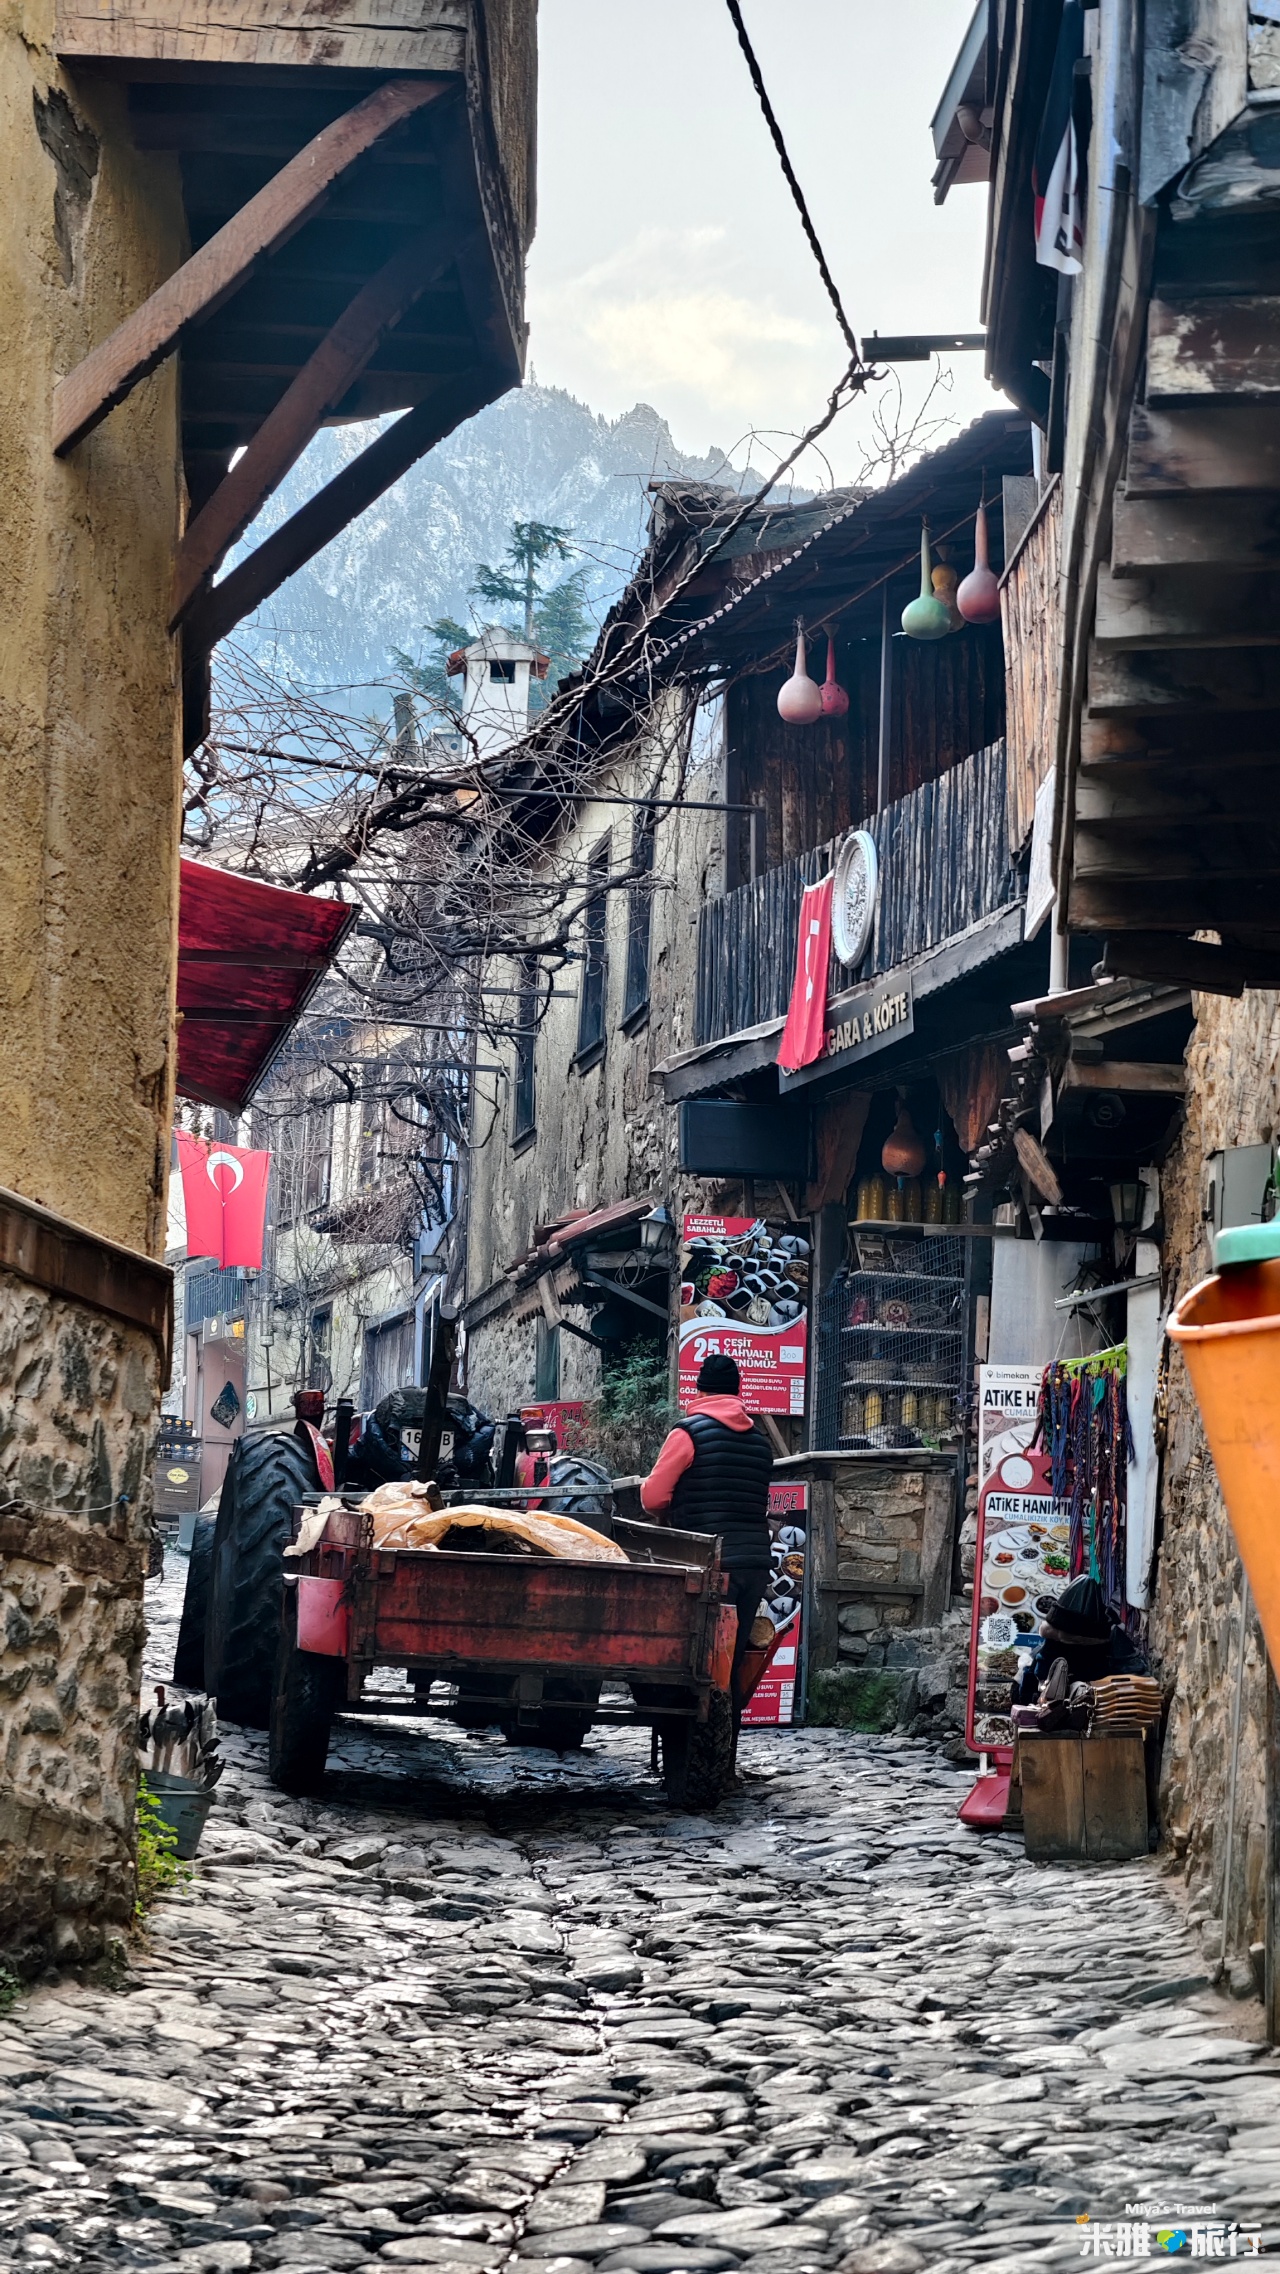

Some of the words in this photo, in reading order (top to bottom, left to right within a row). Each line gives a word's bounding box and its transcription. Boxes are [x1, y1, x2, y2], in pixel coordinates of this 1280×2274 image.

[864, 1012, 873, 1039] &
[874, 992, 907, 1035] KÖFTE
[690, 1218, 724, 1227] LEZZETLİ
[687, 1226, 726, 1234] SABAHLAR
[723, 1336, 753, 1349] ÇEŞİT
[694, 1337, 720, 1362] 25
[723, 1347, 773, 1359] KAHVALTI
[734, 1358, 777, 1370] ENÜMÜZ
[680, 1374, 698, 1382] MAN
[996, 1371, 1030, 1380] bimekan
[1004, 1408, 1036, 1417] CUMALI
[406, 1431, 421, 1444] 16
[1022, 1499, 1071, 1516] HANIM'I
